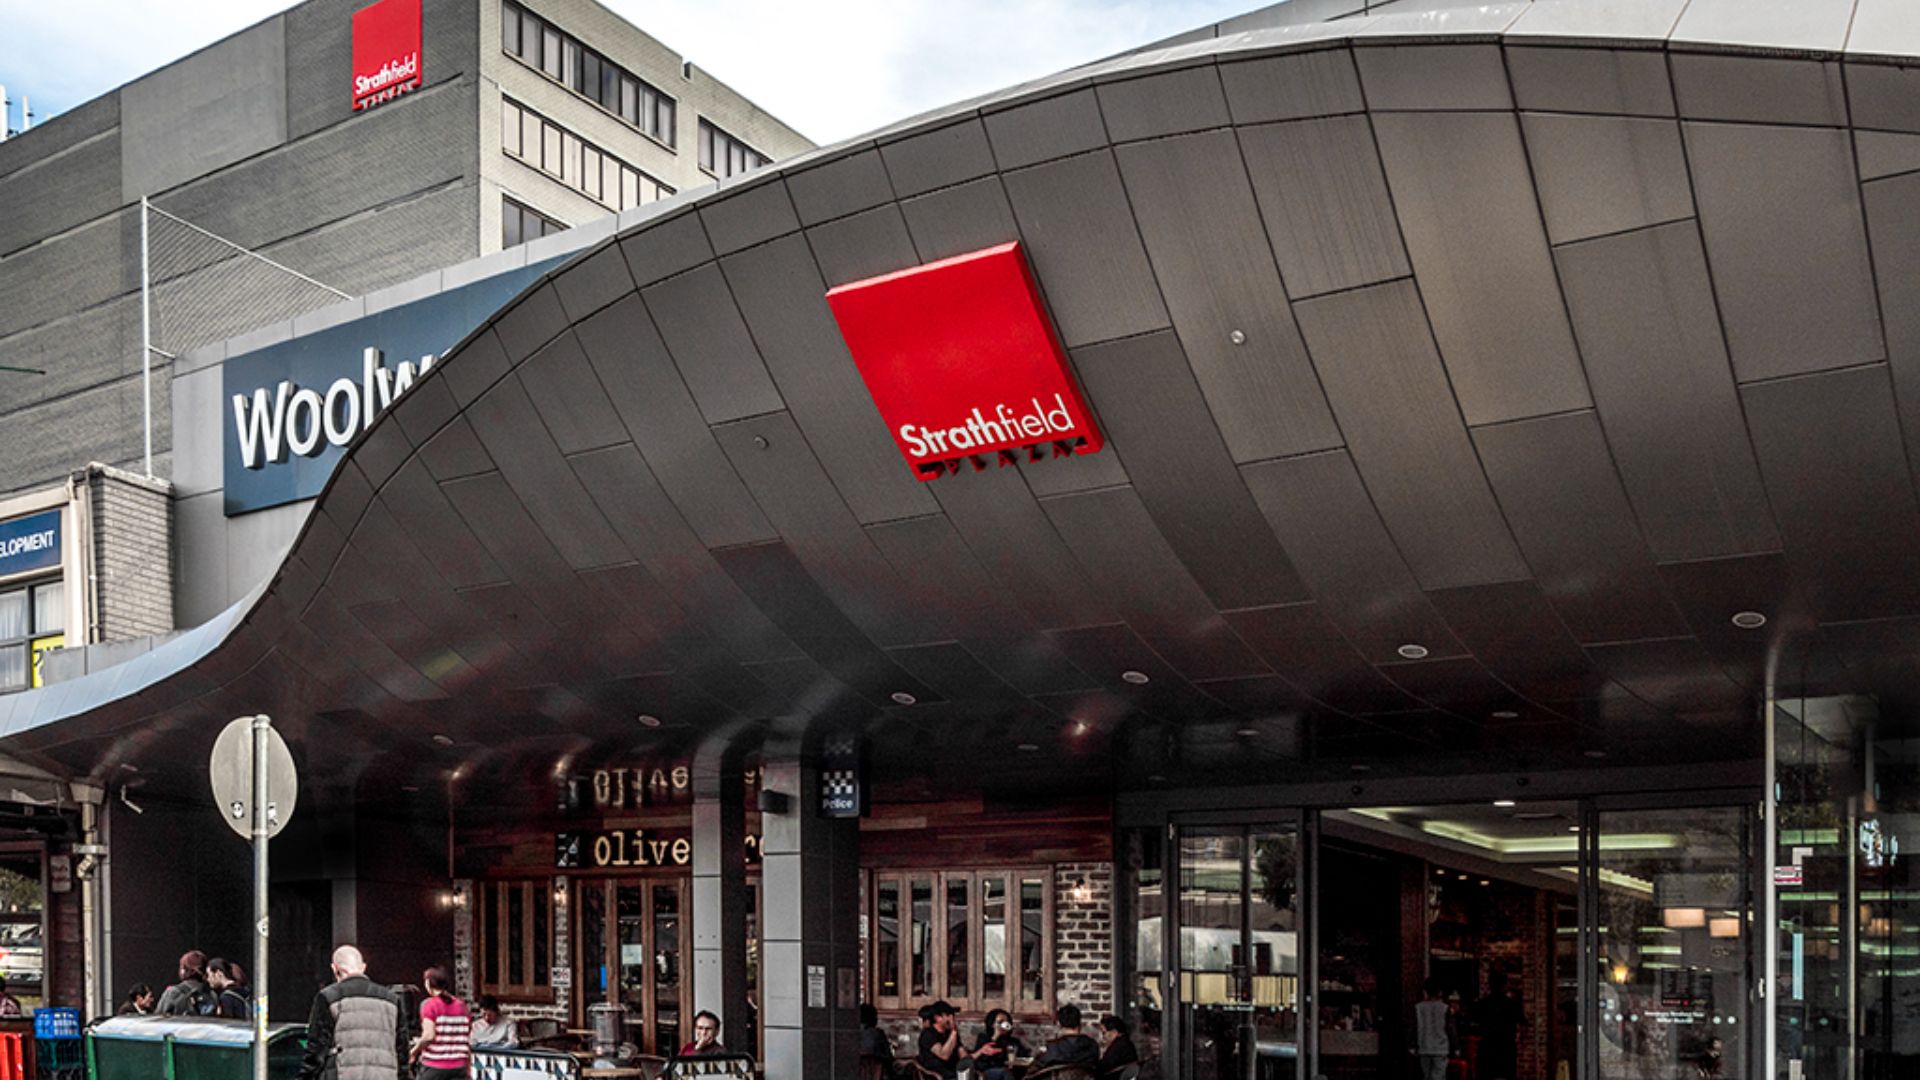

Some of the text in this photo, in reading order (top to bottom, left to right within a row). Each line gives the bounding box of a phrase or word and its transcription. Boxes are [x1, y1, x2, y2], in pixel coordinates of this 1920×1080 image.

[355, 52, 417, 94] Strathfield
[232, 346, 449, 468] Woolw
[900, 392, 1075, 458] Strathfield
[823, 798, 854, 809] Police
